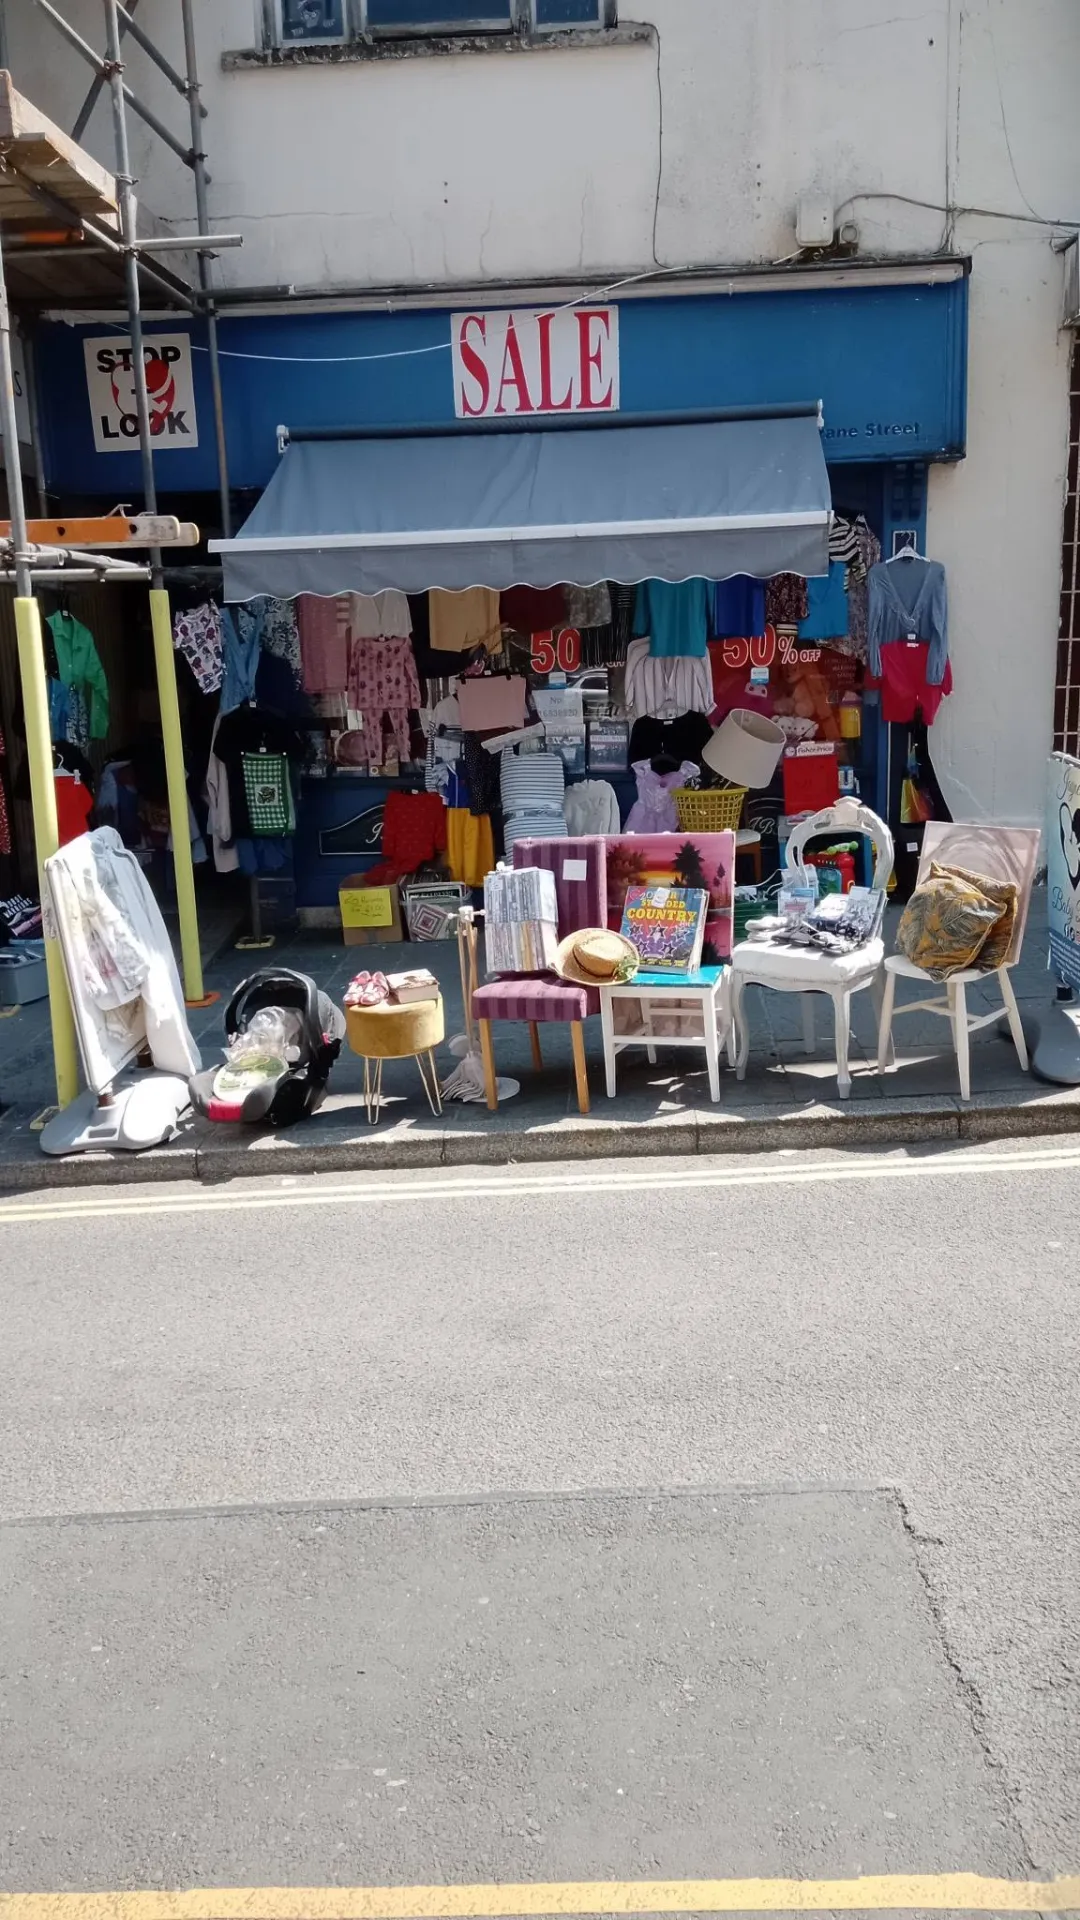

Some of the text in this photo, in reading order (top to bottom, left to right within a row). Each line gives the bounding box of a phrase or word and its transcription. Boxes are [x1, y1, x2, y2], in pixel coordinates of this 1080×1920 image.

[96, 345, 182, 374] STOP
[459, 311, 613, 417] SALE
[100, 410, 191, 439] LOOK
[864, 421, 920, 438] Street
[799, 649, 822, 663] OFF
[640, 898, 686, 910] STDED
[625, 907, 698, 924] COUNTRY
